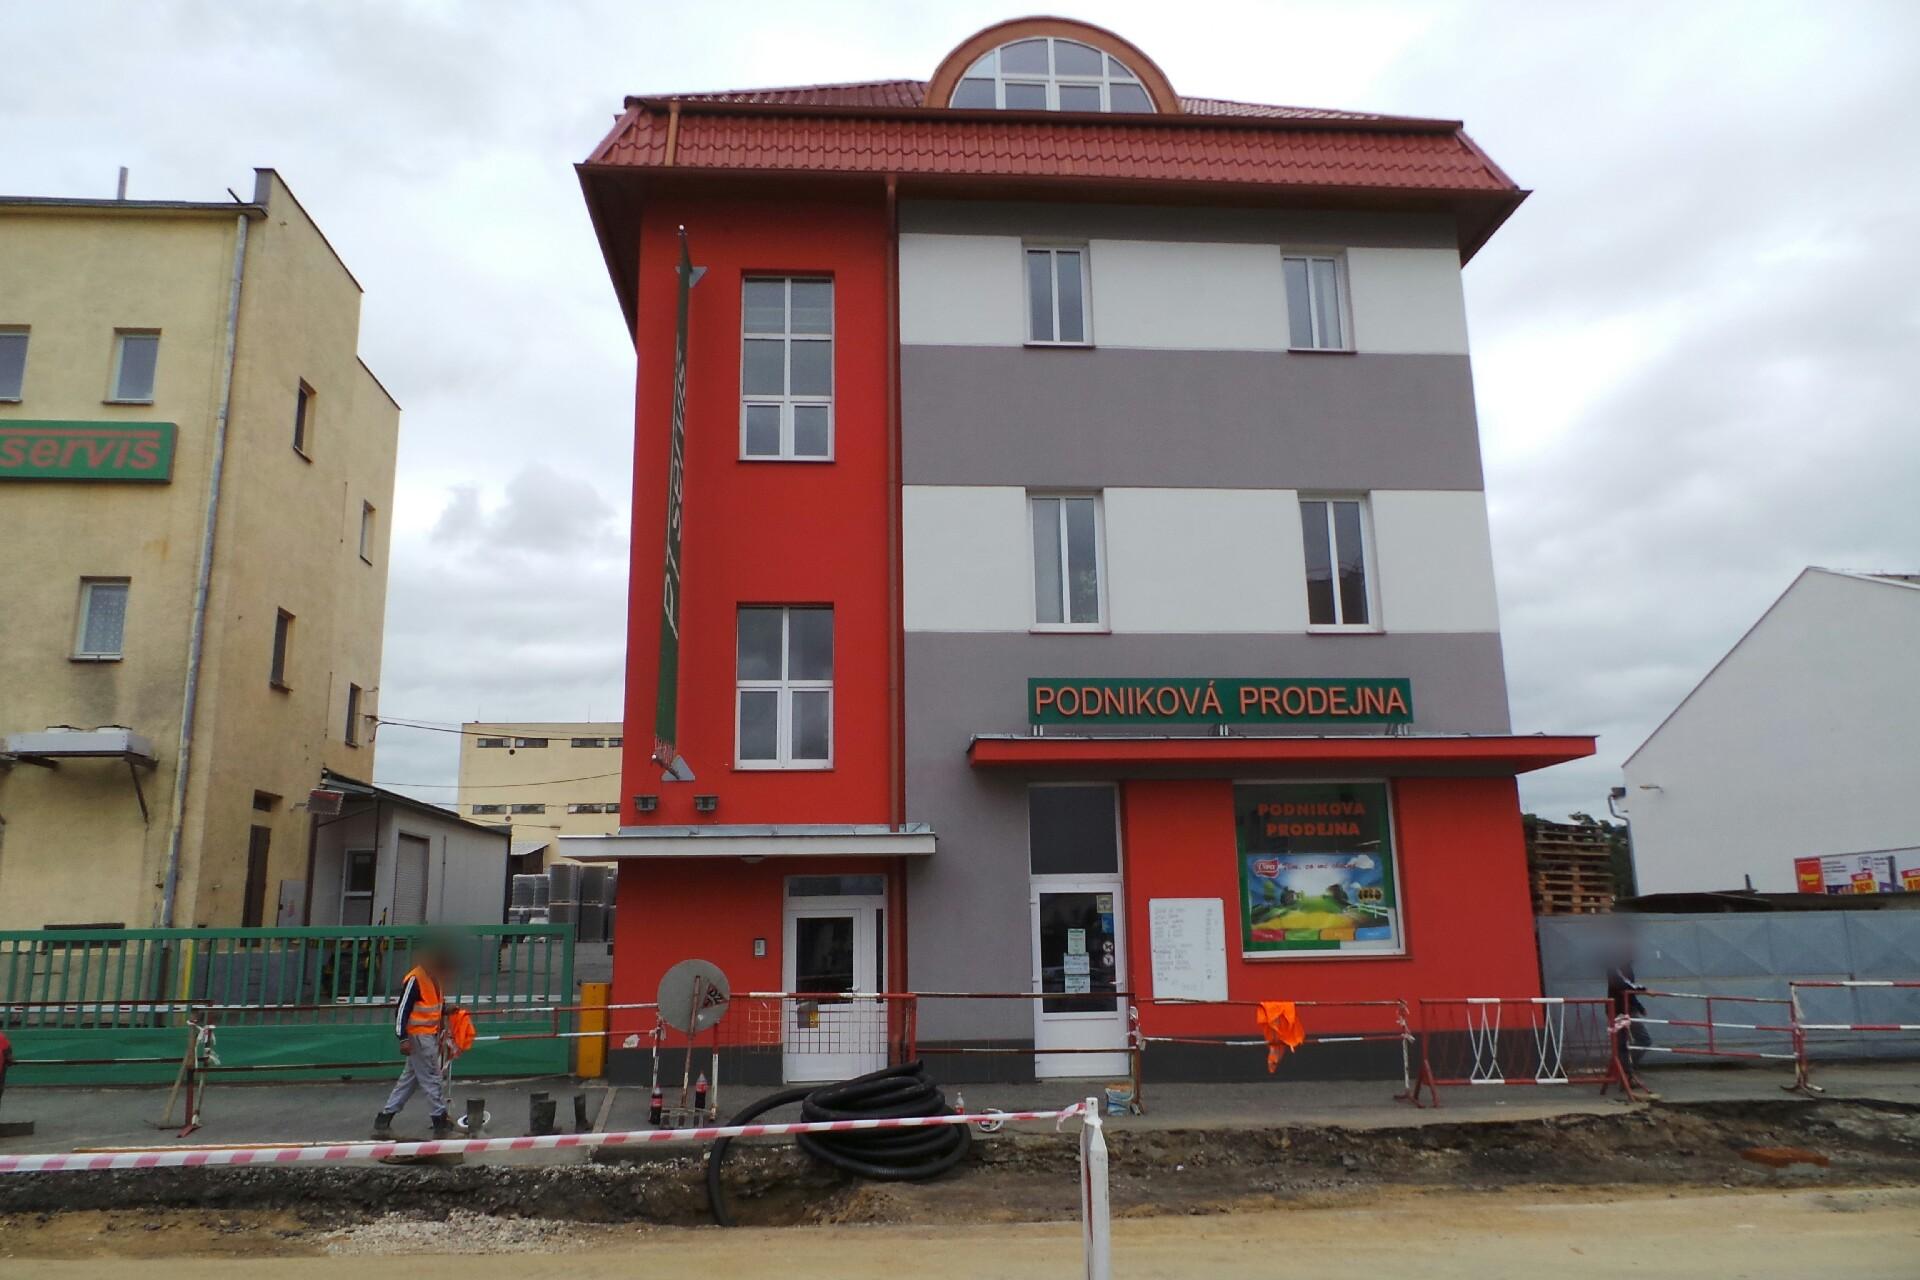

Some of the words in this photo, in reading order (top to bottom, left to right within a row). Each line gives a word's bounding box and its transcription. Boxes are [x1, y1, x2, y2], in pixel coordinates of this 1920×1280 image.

[0, 438, 160, 469] servis
[1035, 681, 1224, 715] PODNIKOVÁ
[1239, 686, 1407, 715] PRODEJNA
[1266, 822, 1360, 837] PRODEJNA
